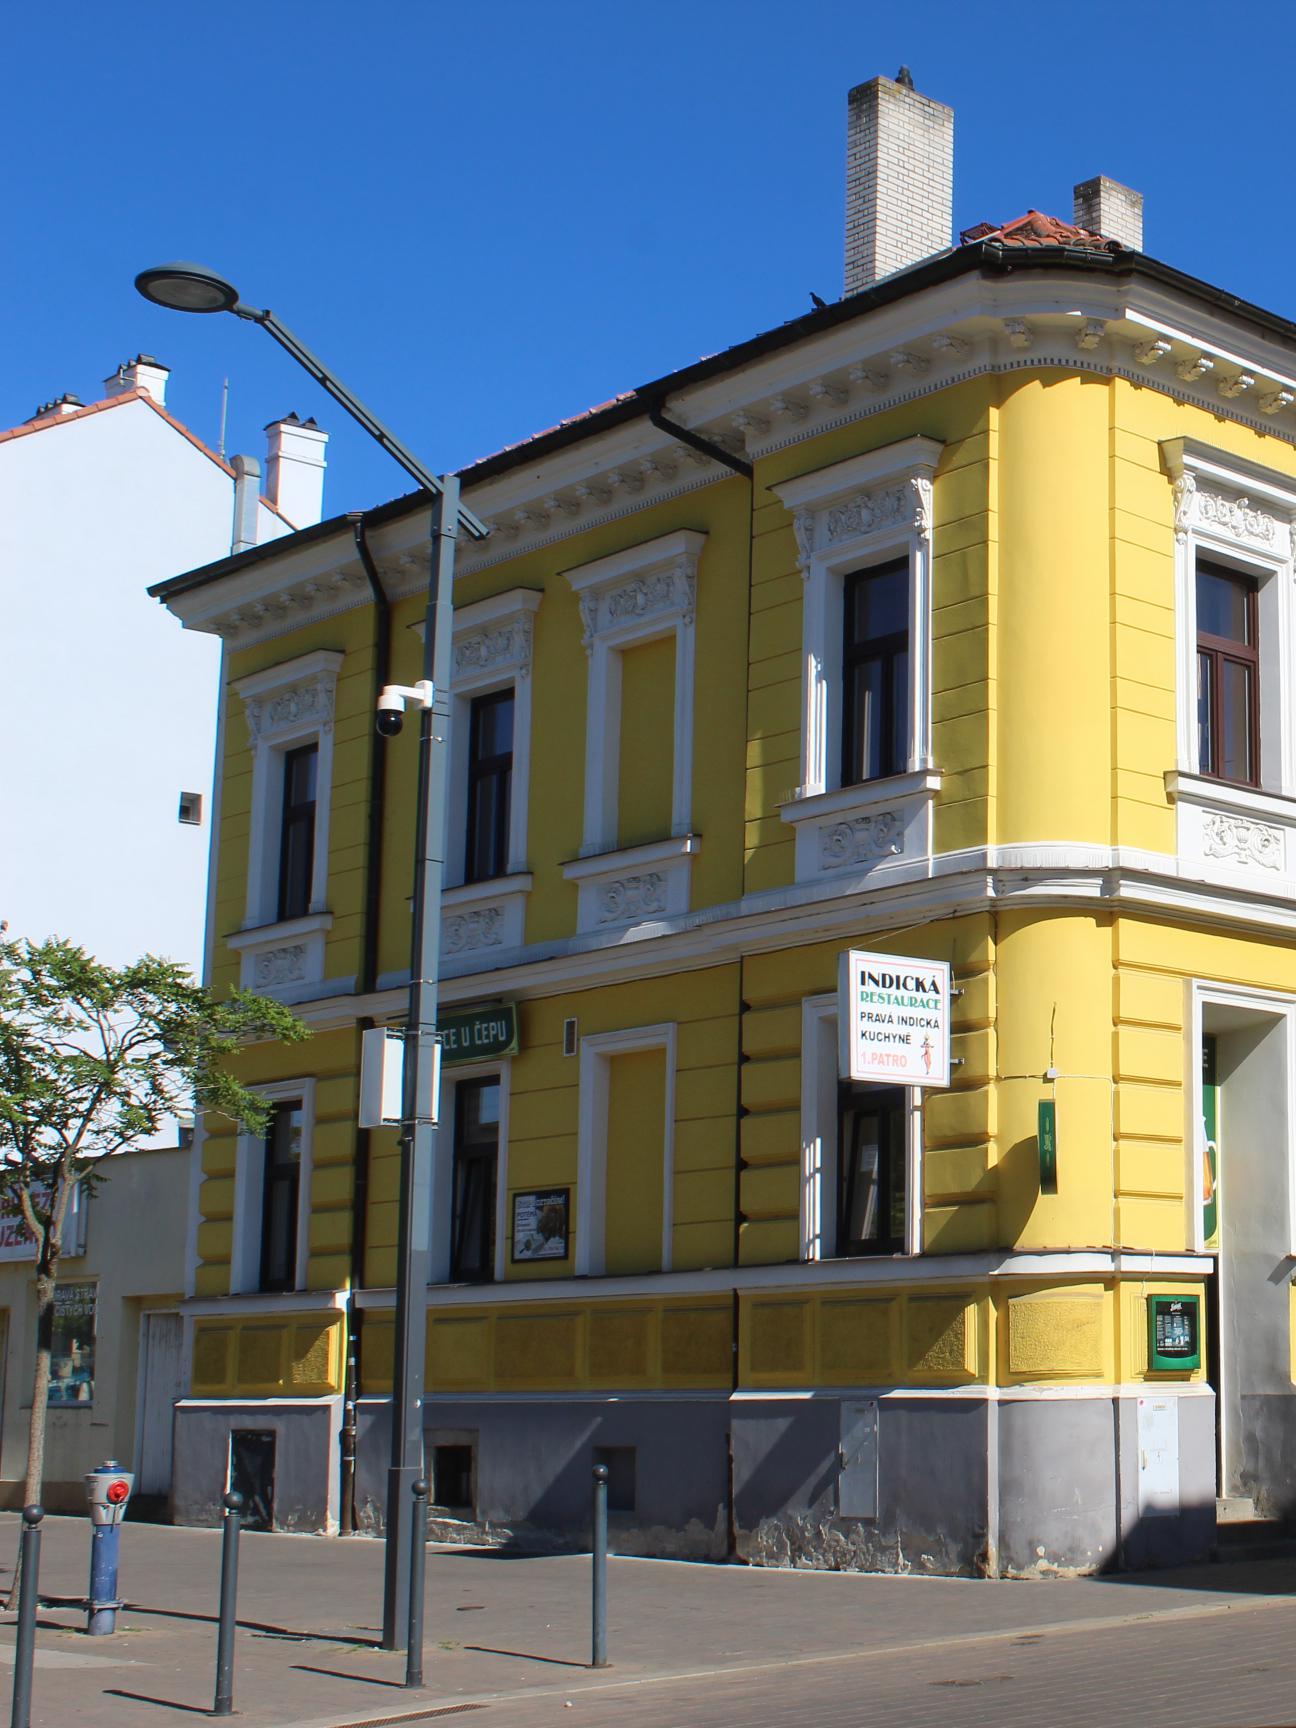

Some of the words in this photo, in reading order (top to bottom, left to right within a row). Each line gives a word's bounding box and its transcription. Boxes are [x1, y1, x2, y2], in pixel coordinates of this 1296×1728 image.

[860, 971, 940, 995] INDICKÁ
[860, 991, 941, 1010] RESTAURACE
[860, 1011, 894, 1024] PRAVÁ
[897, 1015, 940, 1029] INDICKÁ
[461, 1026, 470, 1047] U
[474, 1020, 506, 1044] ČEPU
